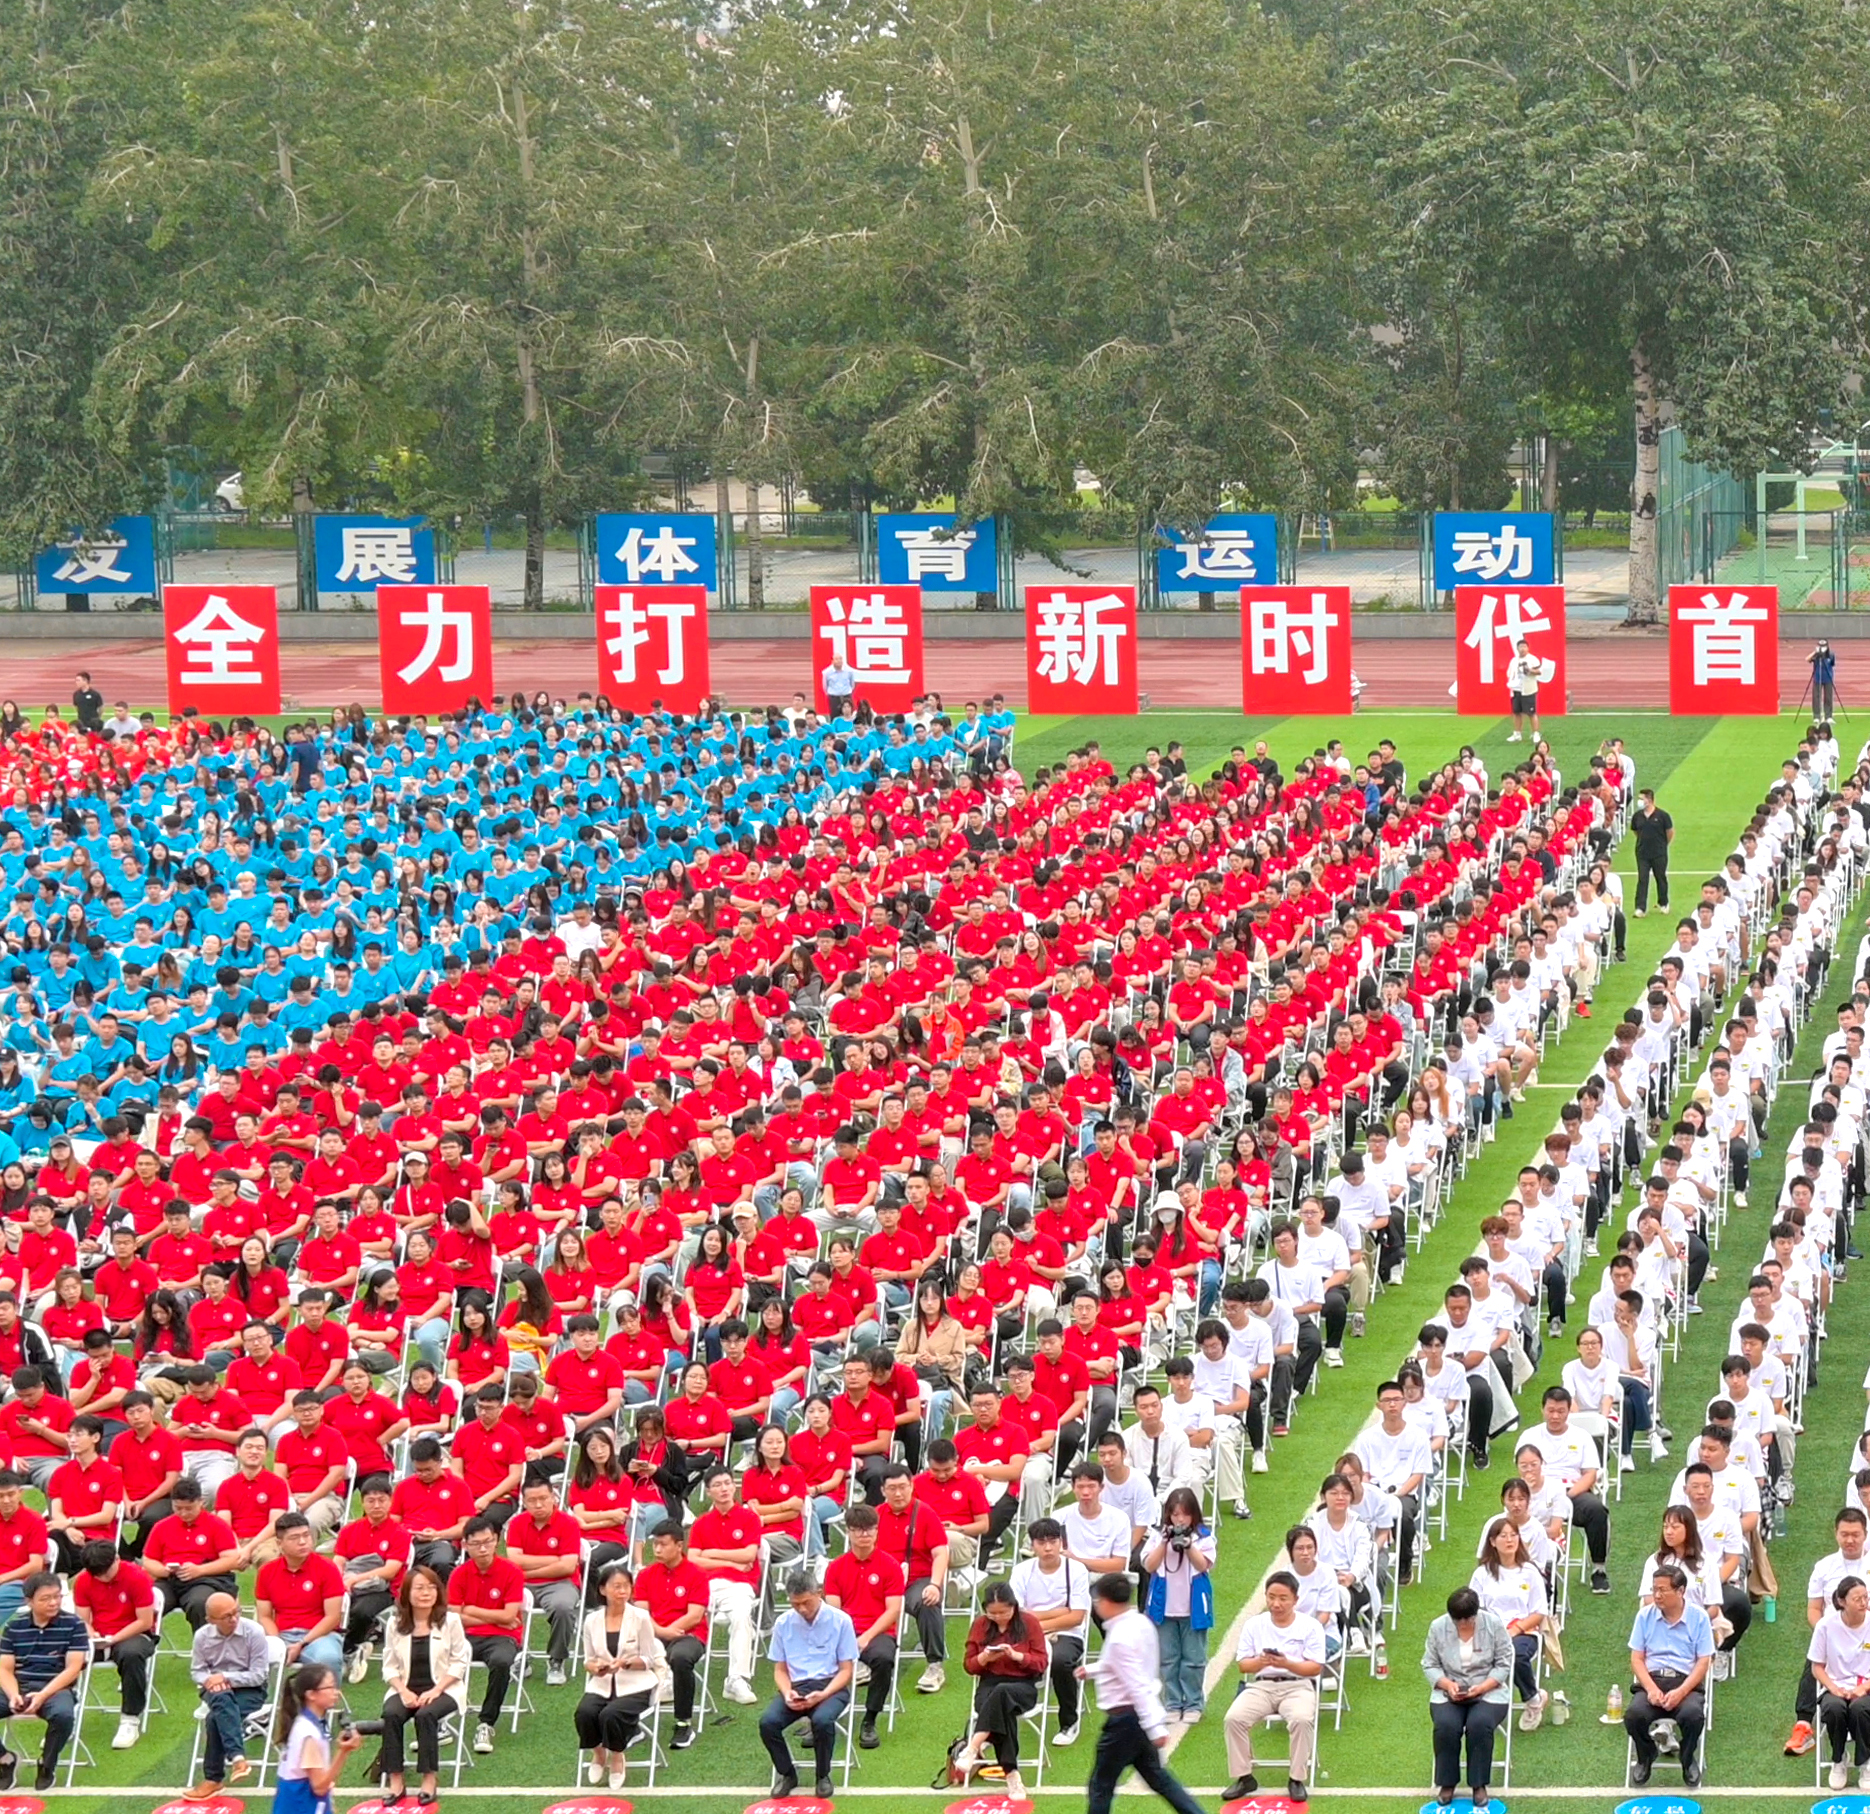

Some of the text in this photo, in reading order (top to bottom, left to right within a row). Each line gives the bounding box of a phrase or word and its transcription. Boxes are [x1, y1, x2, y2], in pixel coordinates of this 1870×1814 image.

[337, 529, 416, 582] 展
[616, 528, 698, 581] 体
[896, 527, 976, 581] 育
[1176, 531, 1256, 578] 运
[1453, 526, 1532, 579] 动
[174, 595, 264, 683] 全
[398, 593, 472, 684] 力
[605, 593, 695, 684] 打
[821, 595, 911, 684] 造
[1036, 593, 1126, 685] 新
[1251, 594, 1338, 684] 时
[1465, 595, 1555, 684] 代
[1678, 593, 1767, 685] 首
